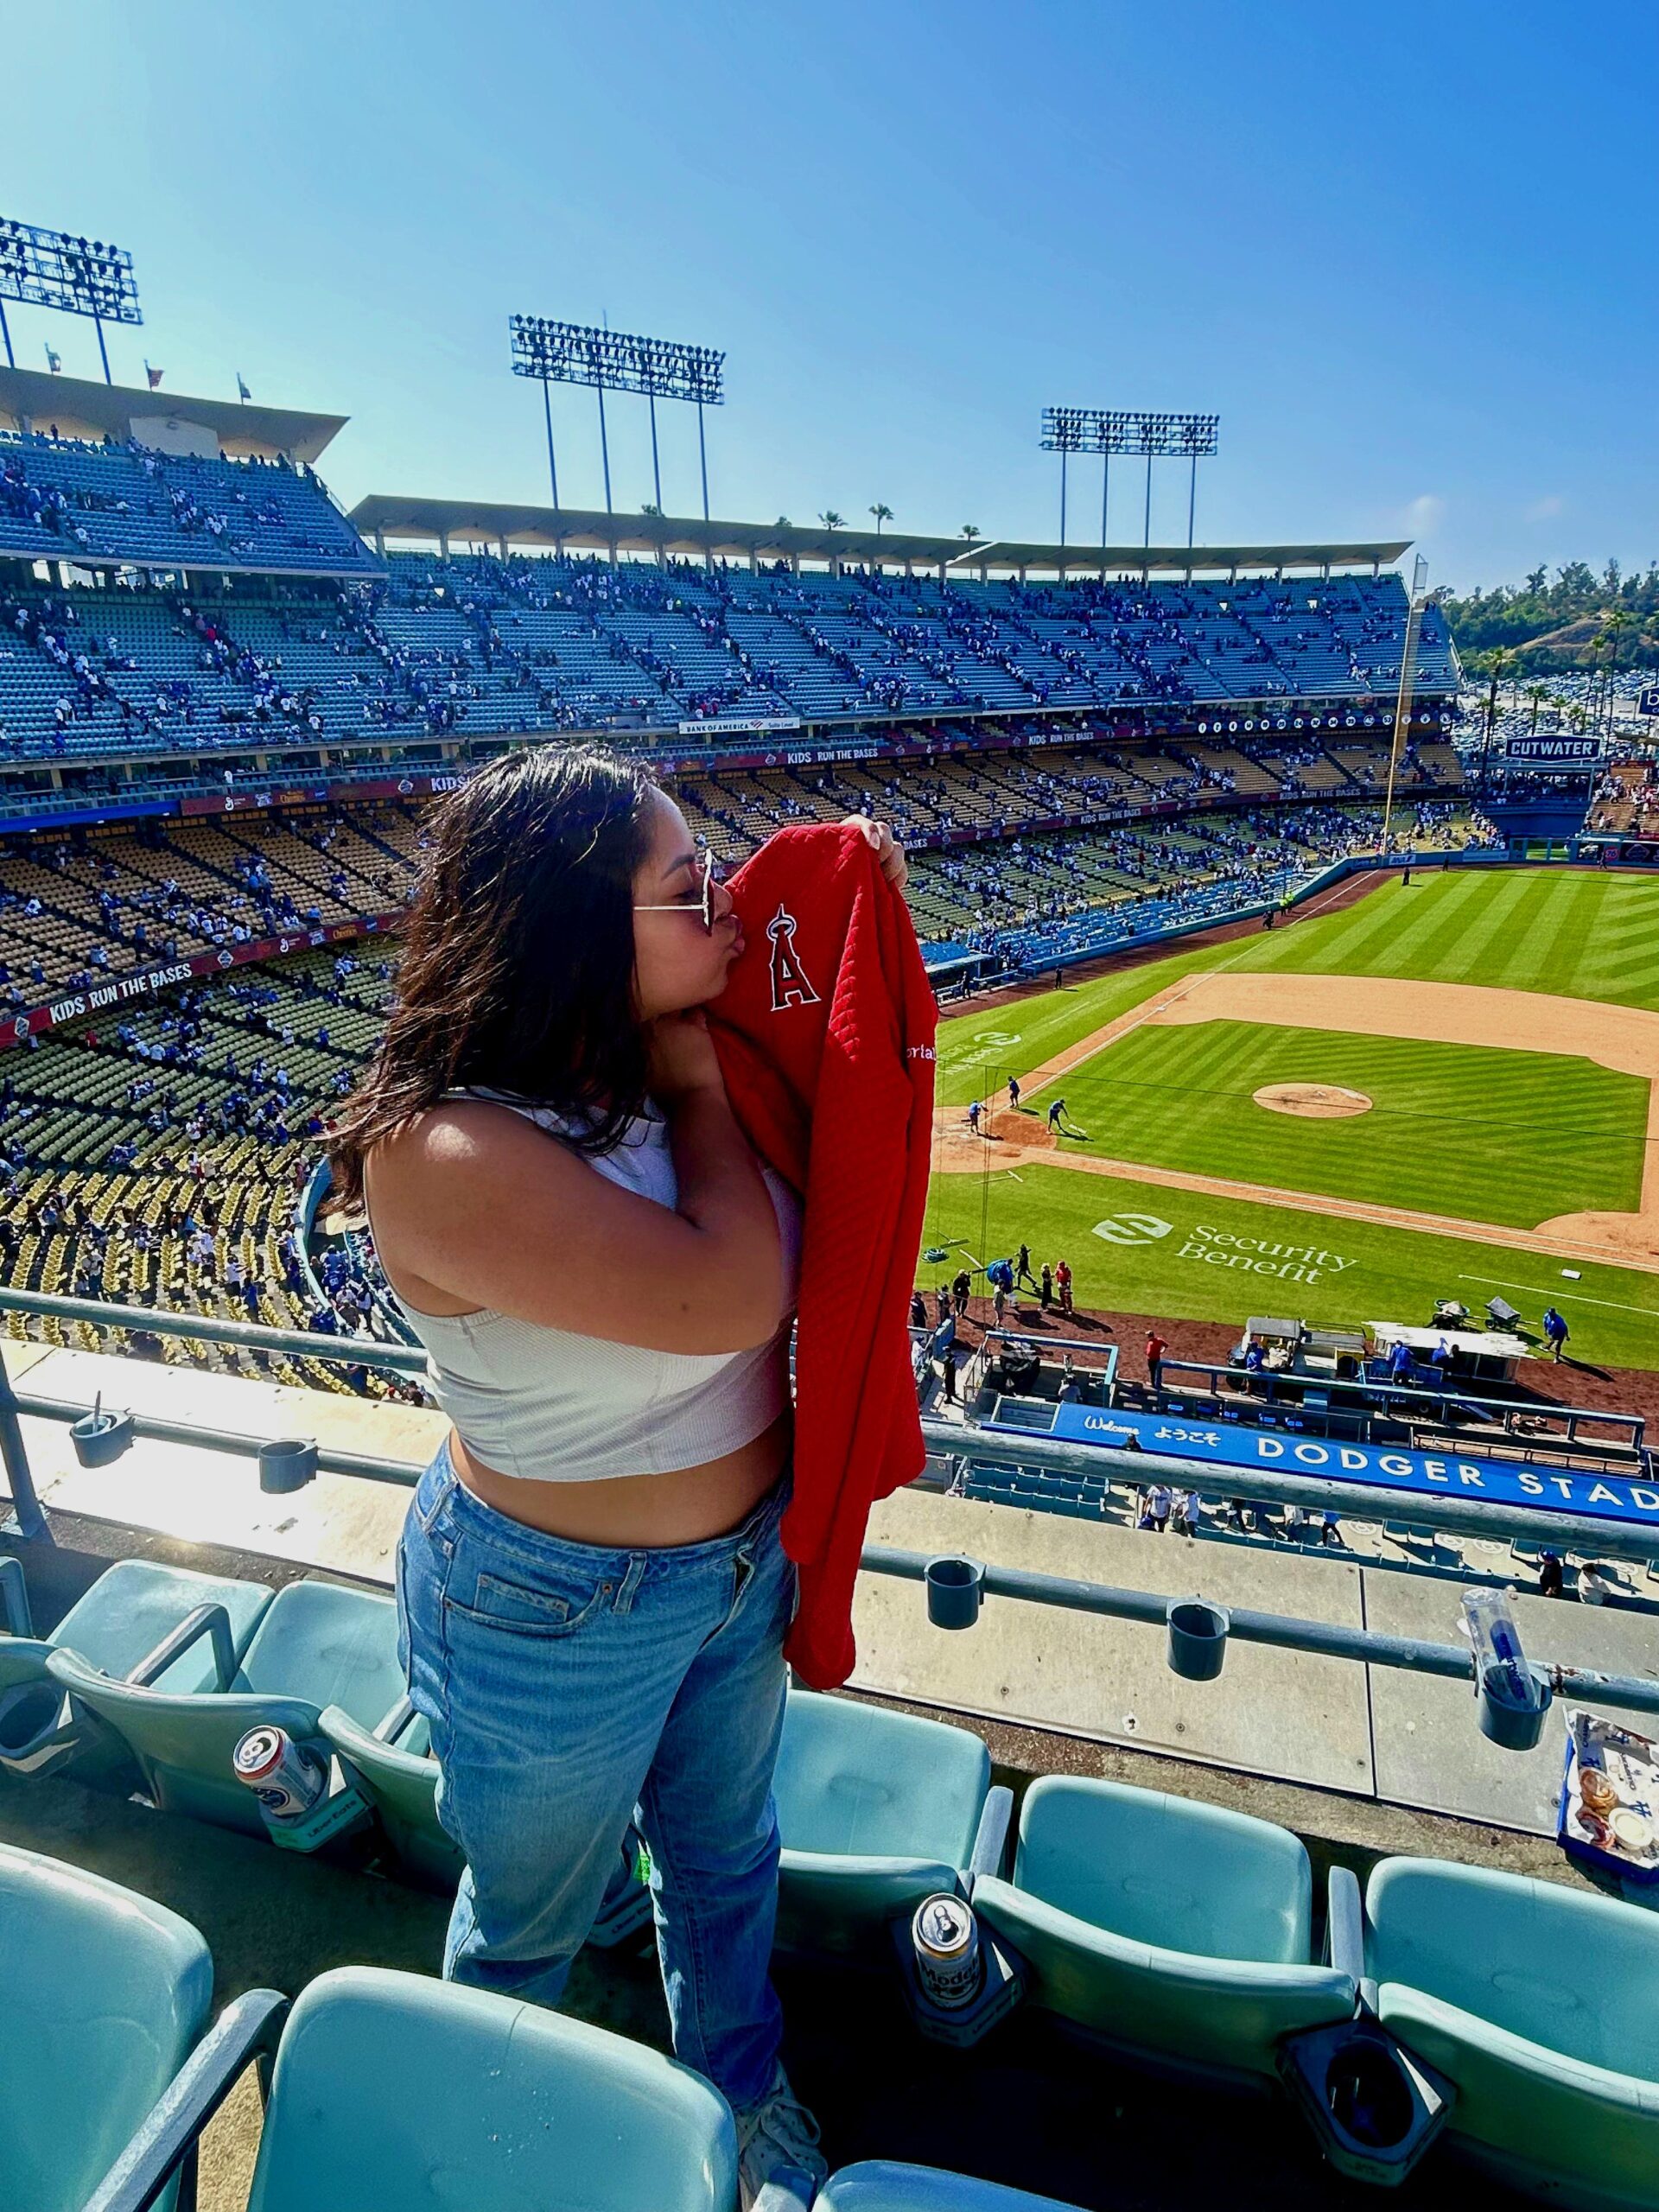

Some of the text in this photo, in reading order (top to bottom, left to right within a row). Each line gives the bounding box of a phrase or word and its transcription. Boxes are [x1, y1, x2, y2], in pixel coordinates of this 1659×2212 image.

[718, 722, 749, 731] AMERICA
[1028, 734, 1046, 746] KIDS
[1510, 741, 1593, 755] CUTWATER
[787, 747, 879, 765] KIDS RUN THE BASES
[431, 775, 467, 791] KIDS
[766, 903, 822, 1012] A
[49, 963, 193, 1024] KIDS RUN THE BASES
[1189, 1225, 1360, 1273] Security
[1174, 1241, 1324, 1285] Benefit
[1084, 1414, 1141, 1436] Welcome
[1154, 1426, 1222, 1447] ようこそ
[1257, 1436, 1659, 1511] DODGER STAD
